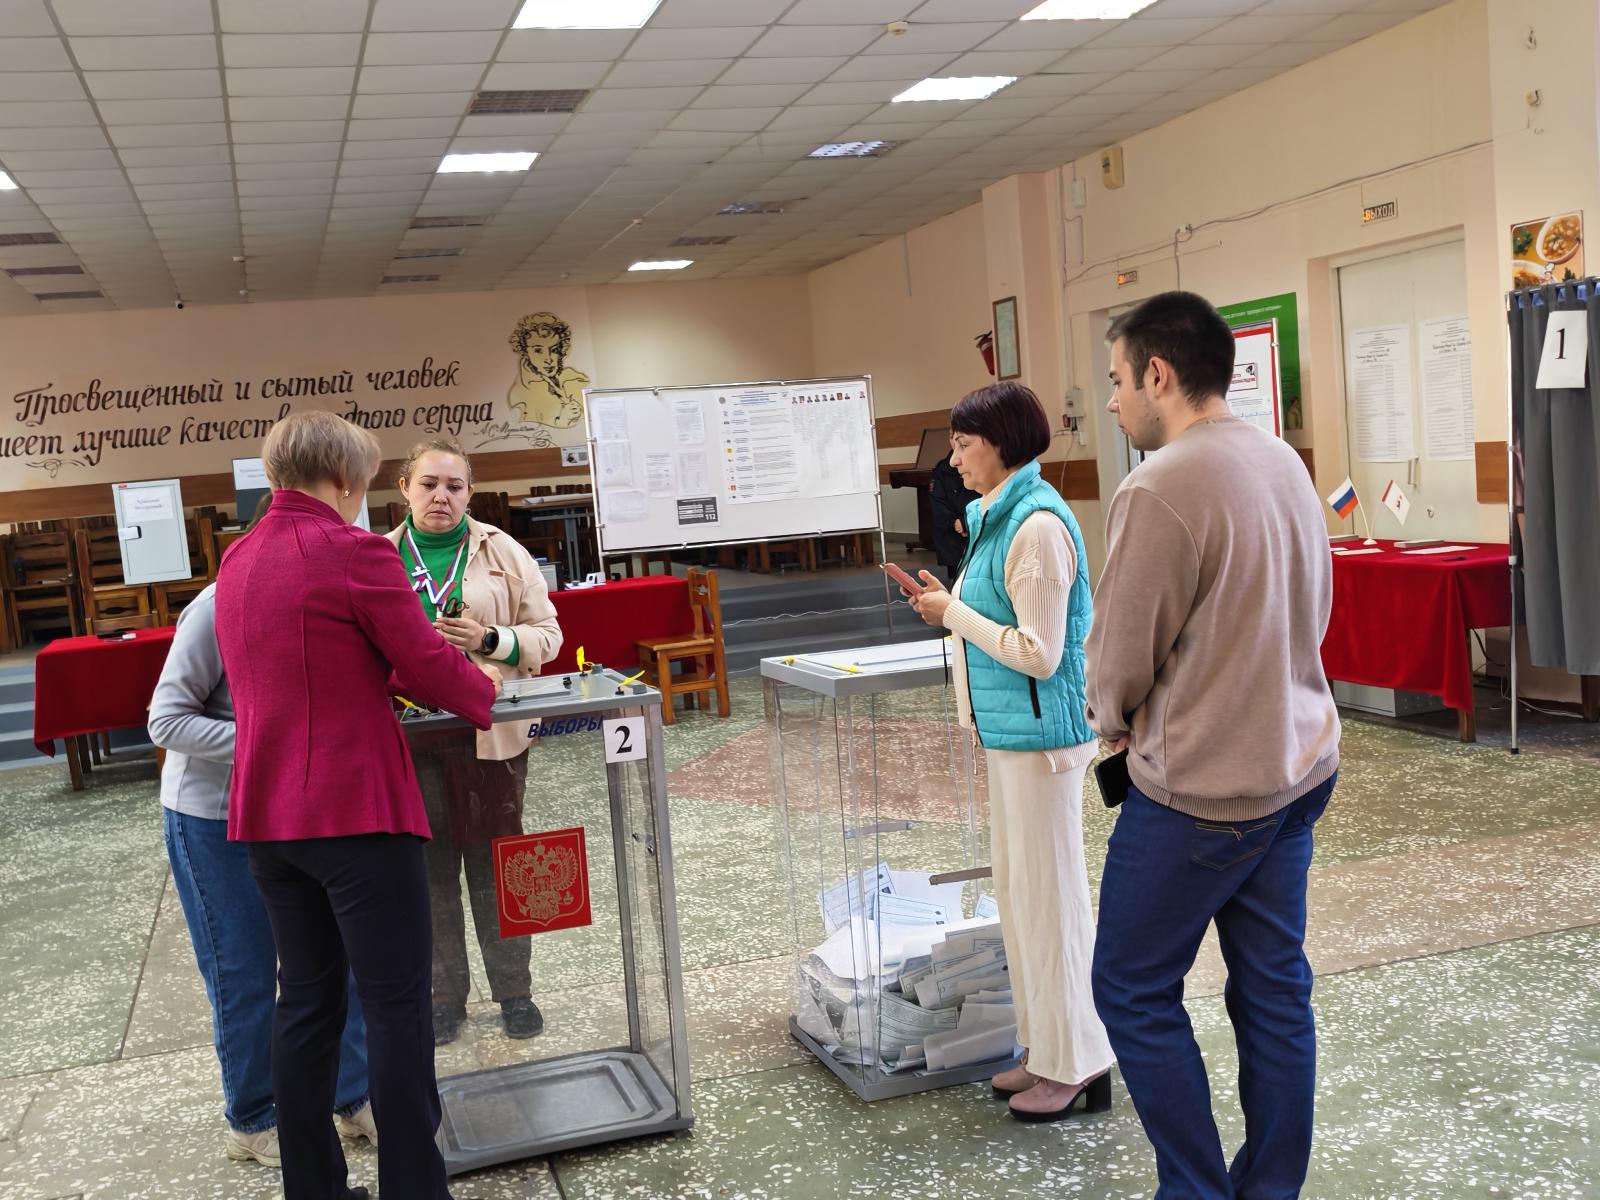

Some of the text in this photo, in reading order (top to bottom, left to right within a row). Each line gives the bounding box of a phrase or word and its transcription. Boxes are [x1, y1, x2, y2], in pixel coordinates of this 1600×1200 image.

[1364, 204, 1395, 221] ВЫХОД
[1554, 327, 1567, 360] 1
[14, 356, 460, 427] Просвещённый и сытый человек
[72, 424, 171, 466] лучшие
[180, 402, 291, 445] качеств
[413, 401, 494, 437] сердца
[527, 716, 604, 738] ВЫБОРЫ
[614, 725, 633, 755] 2
